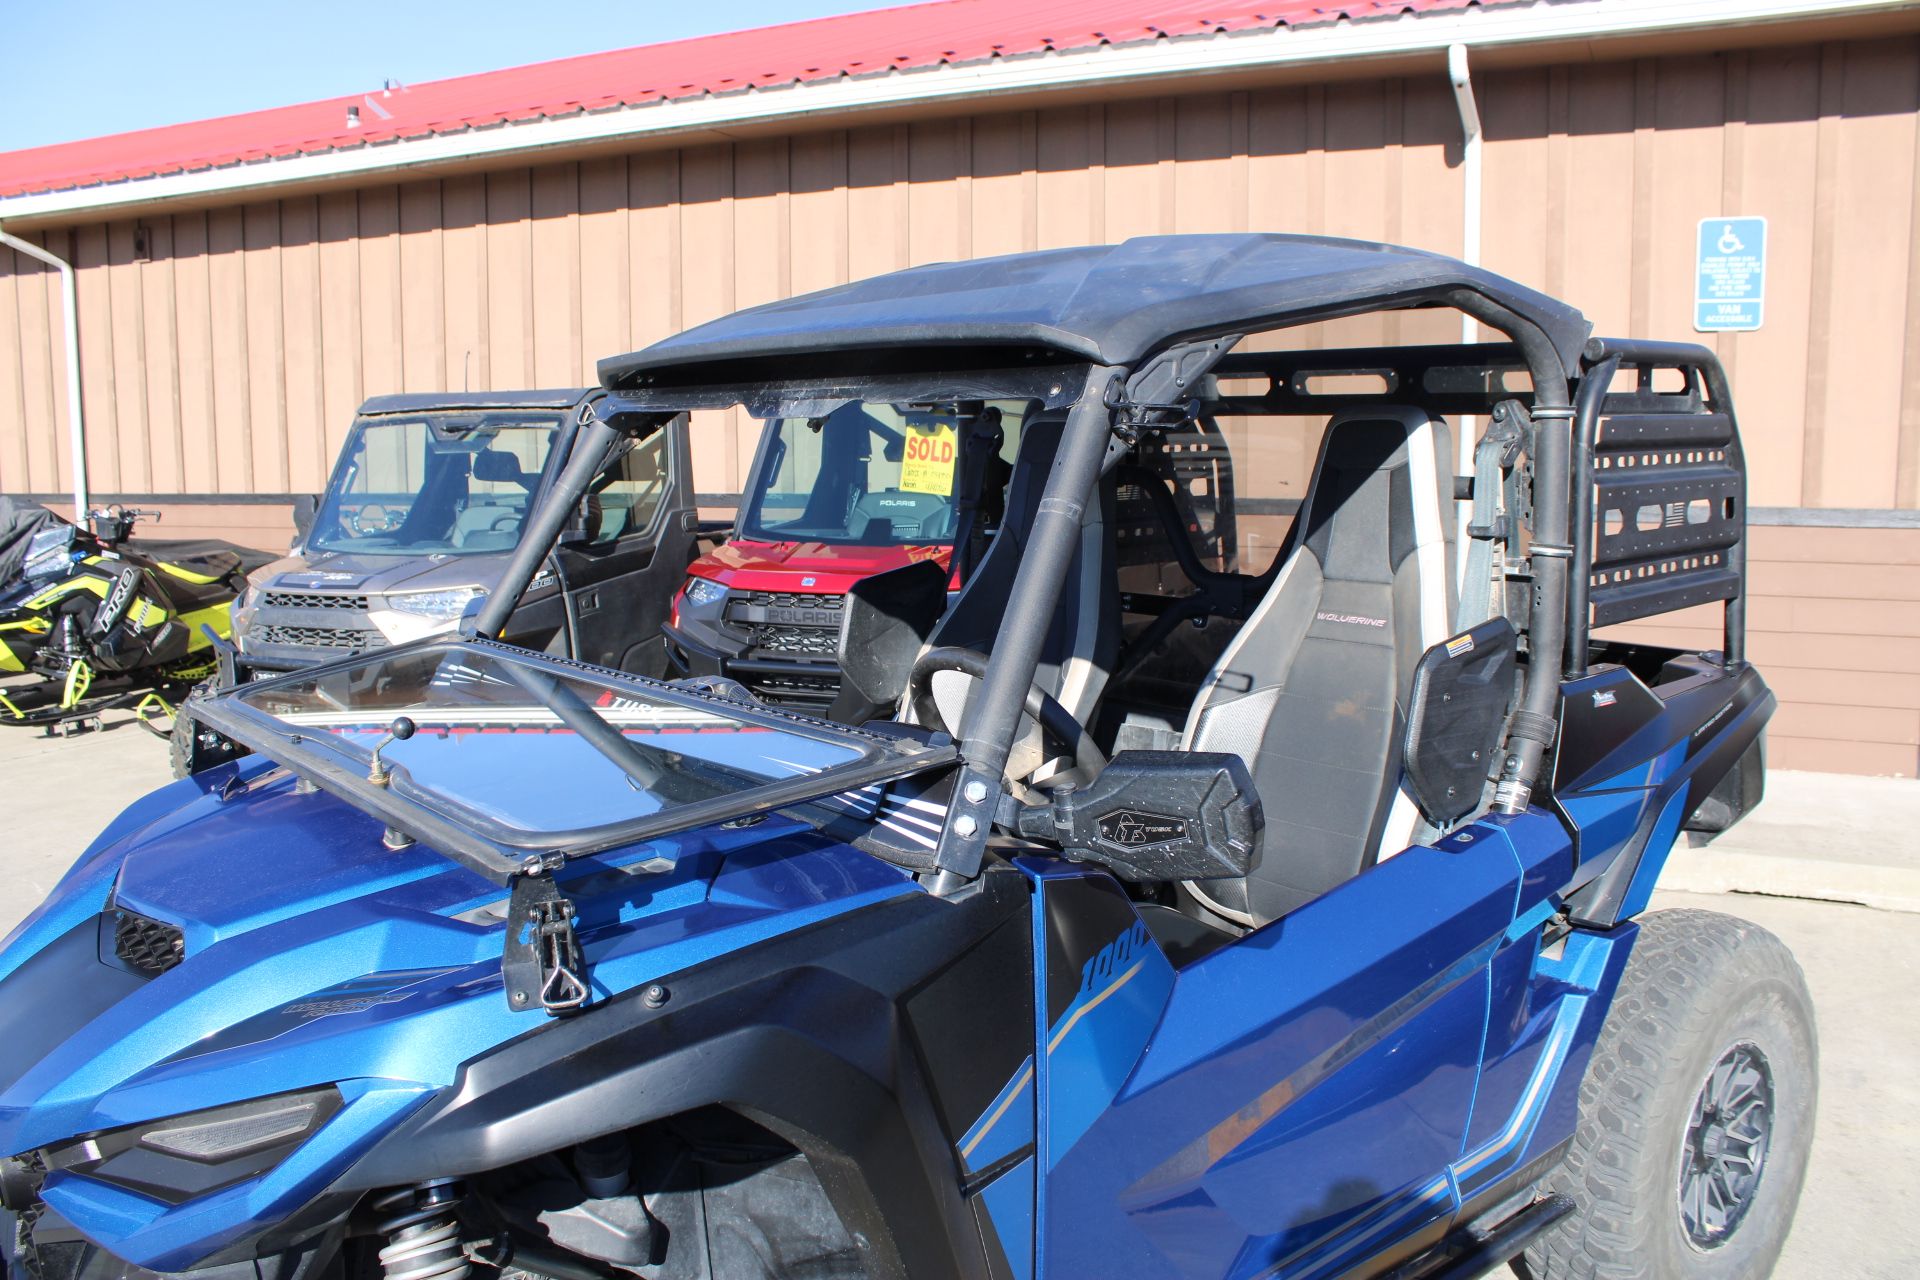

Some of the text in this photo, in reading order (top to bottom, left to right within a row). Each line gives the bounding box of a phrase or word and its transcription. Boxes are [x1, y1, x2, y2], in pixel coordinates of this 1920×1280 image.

[1717, 304, 1741, 314] VAN
[906, 436, 953, 464] SOLD
[99, 567, 134, 633] PRO
[767, 609, 842, 624] POLARIS
[1316, 612, 1388, 627] WOLVERINE
[1080, 918, 1147, 992] 1000
